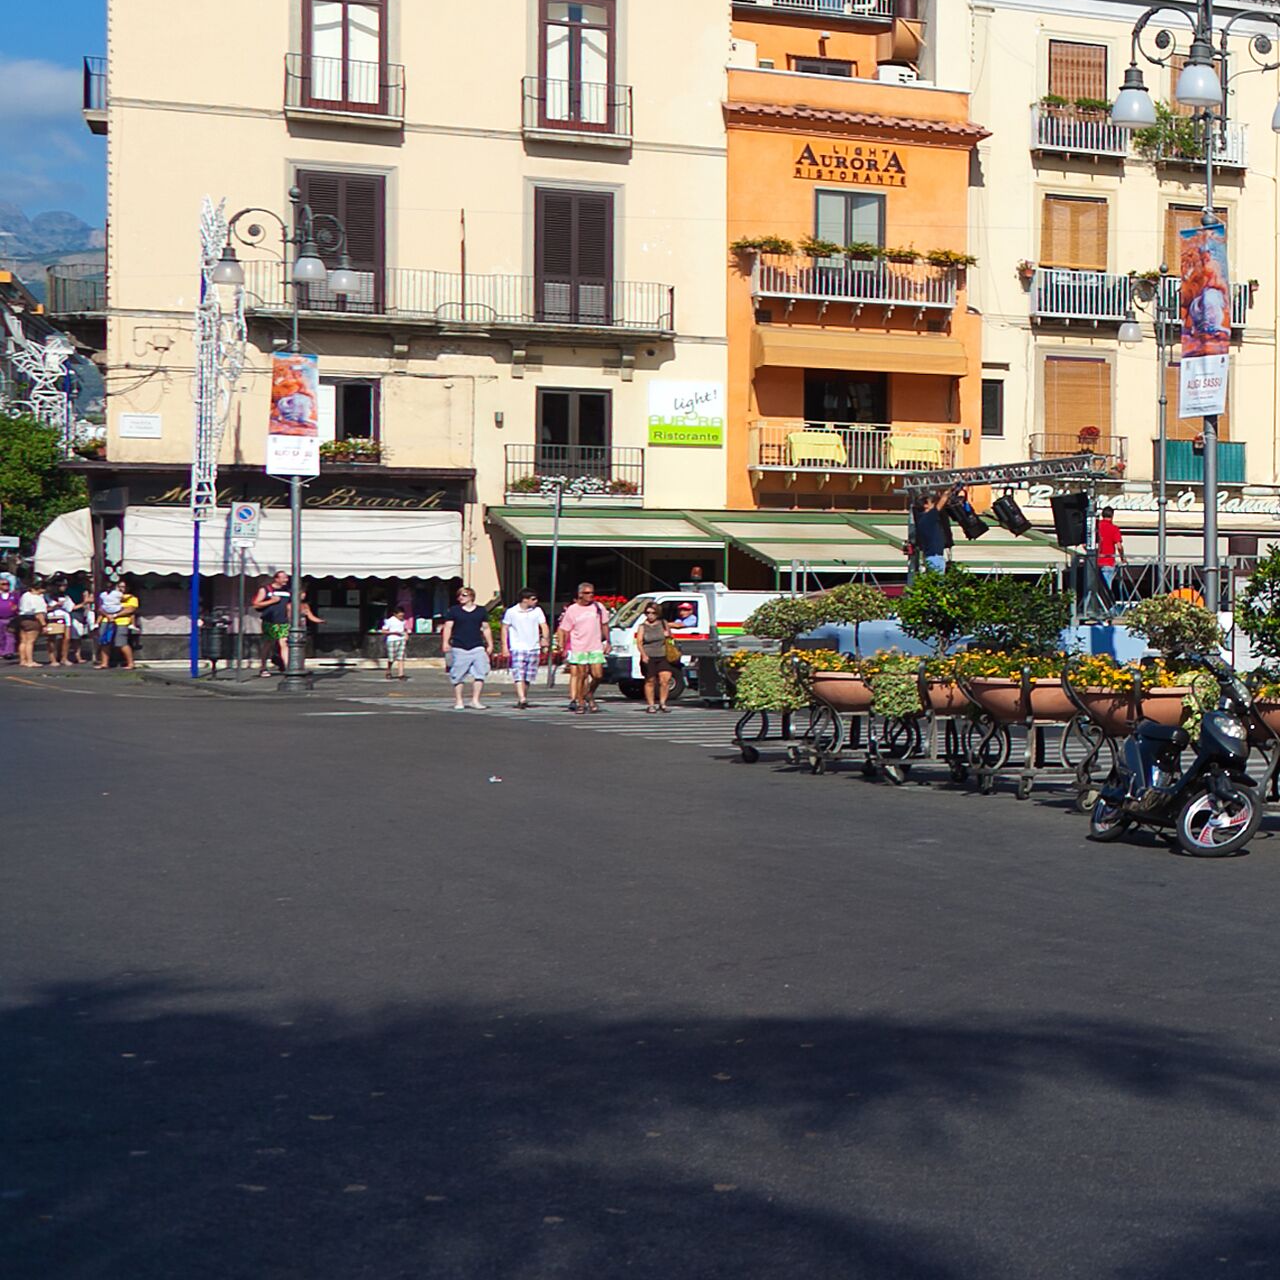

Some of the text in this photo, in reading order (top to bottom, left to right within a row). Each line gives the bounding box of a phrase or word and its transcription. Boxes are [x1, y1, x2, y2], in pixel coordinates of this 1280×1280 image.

[833, 145, 889, 158] LIGHT
[795, 167, 907, 185] RISTORANTE
[674, 389, 717, 415] light!
[653, 431, 719, 442] Ristorante
[305, 486, 447, 508] Branch
